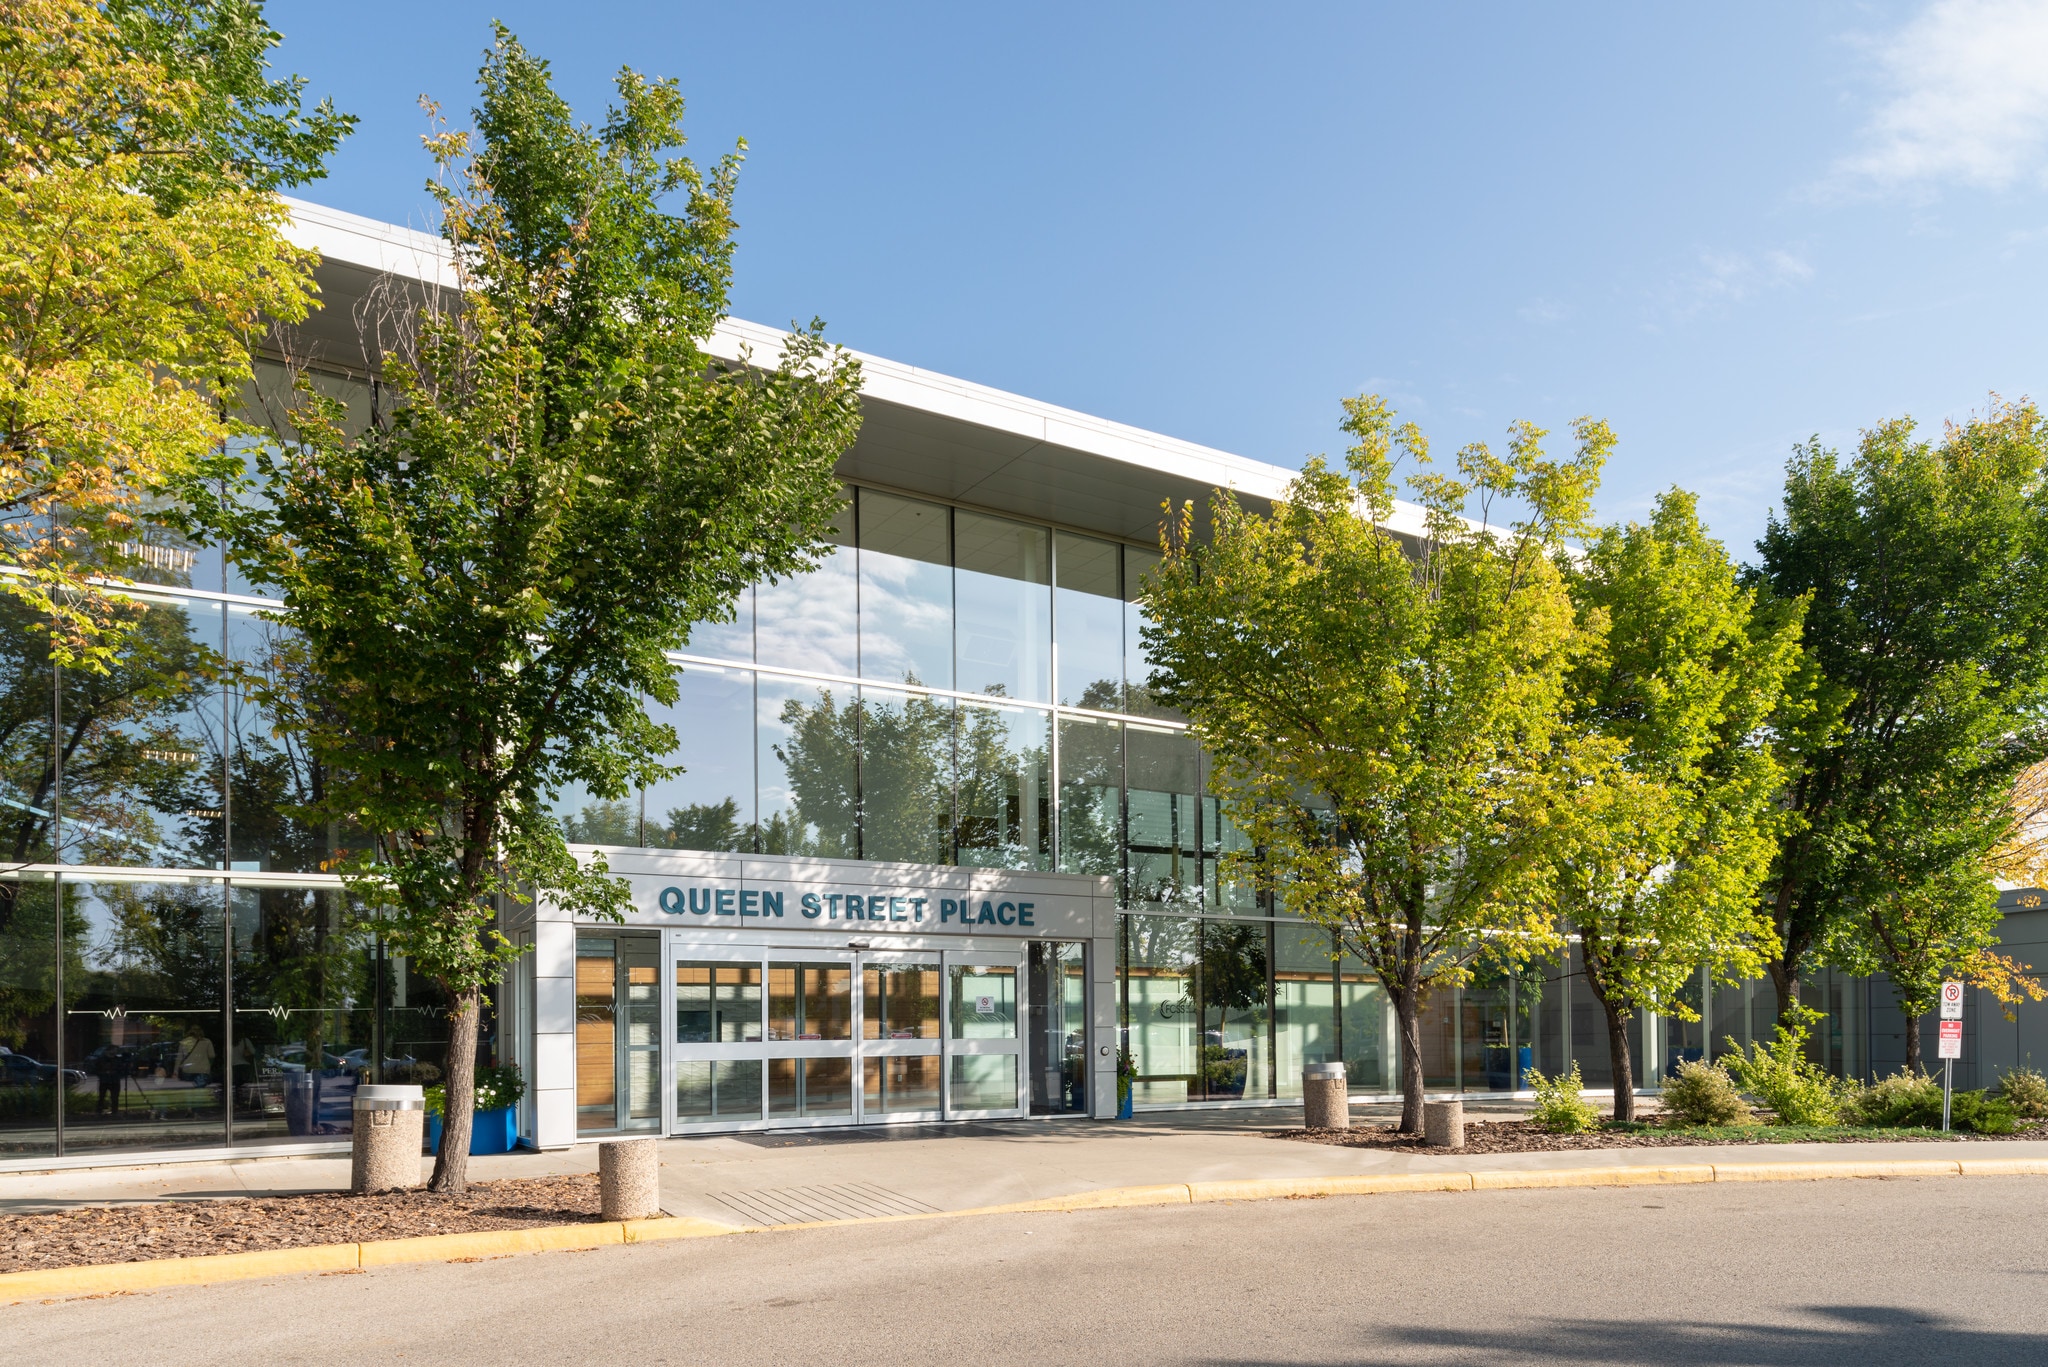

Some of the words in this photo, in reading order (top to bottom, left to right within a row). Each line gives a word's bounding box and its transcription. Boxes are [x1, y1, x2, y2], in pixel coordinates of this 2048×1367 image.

[659, 886, 784, 918] QUEEN
[801, 892, 929, 923] STREET
[940, 898, 1035, 927] PLACE
[1165, 1004, 1185, 1013] FCSS
